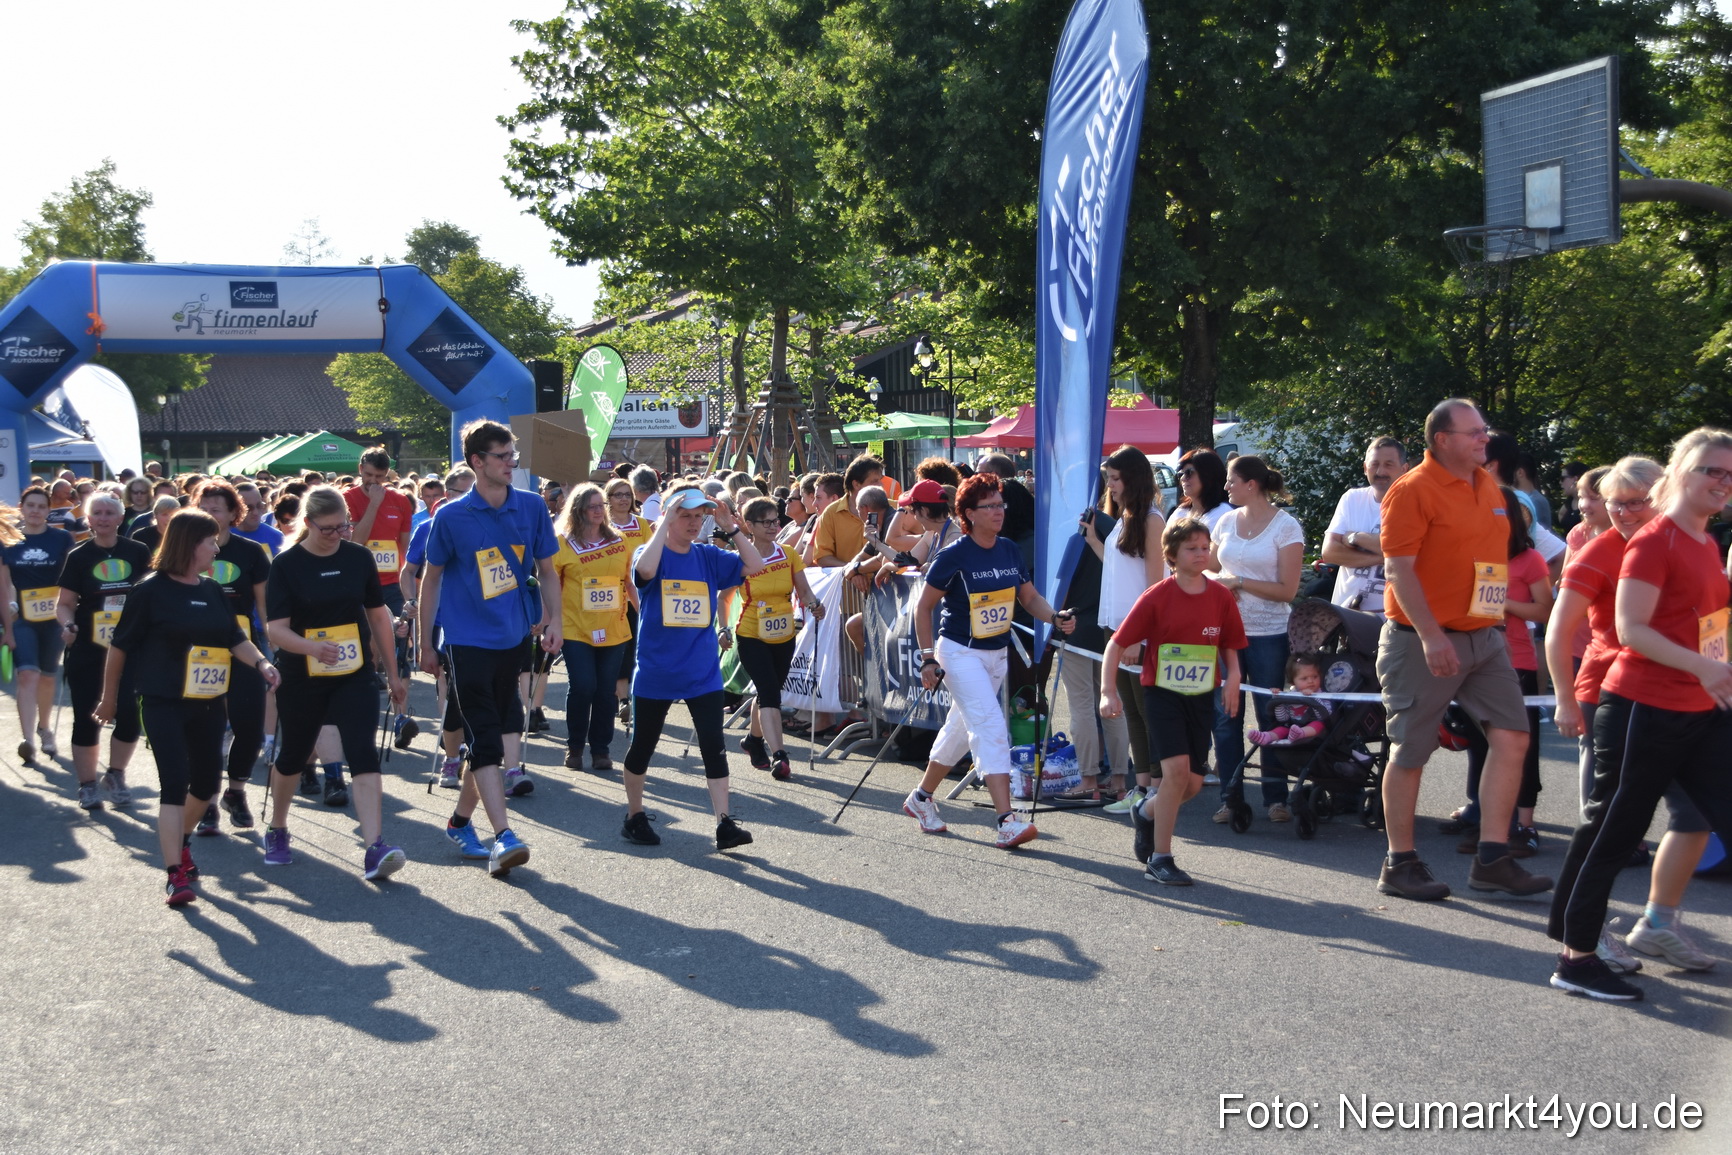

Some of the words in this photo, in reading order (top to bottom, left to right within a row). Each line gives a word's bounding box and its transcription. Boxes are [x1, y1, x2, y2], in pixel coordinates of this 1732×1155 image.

[1067, 29, 1120, 299] Fischer
[240, 290, 276, 299] Fischer
[213, 309, 319, 328] firmenlauf
[213, 328, 258, 336] neumarkt
[5, 345, 65, 357] Fischer
[442, 343, 456, 351] das
[592, 392, 618, 425] AOK
[628, 418, 642, 426] grüßt
[376, 552, 396, 564] 061
[580, 551, 604, 565] MAX
[489, 562, 514, 583] 785
[771, 561, 791, 572] BÖGL
[972, 570, 994, 580] EURO
[1000, 567, 1019, 577] POLES
[590, 590, 614, 603] 895
[1478, 584, 1508, 605] 1033
[32, 600, 55, 613] 185
[672, 598, 701, 615] 782
[980, 606, 1007, 625] 392
[765, 617, 787, 632] 903
[337, 643, 358, 661] 33
[193, 667, 227, 686] 1234
[1163, 664, 1210, 682] 1047
